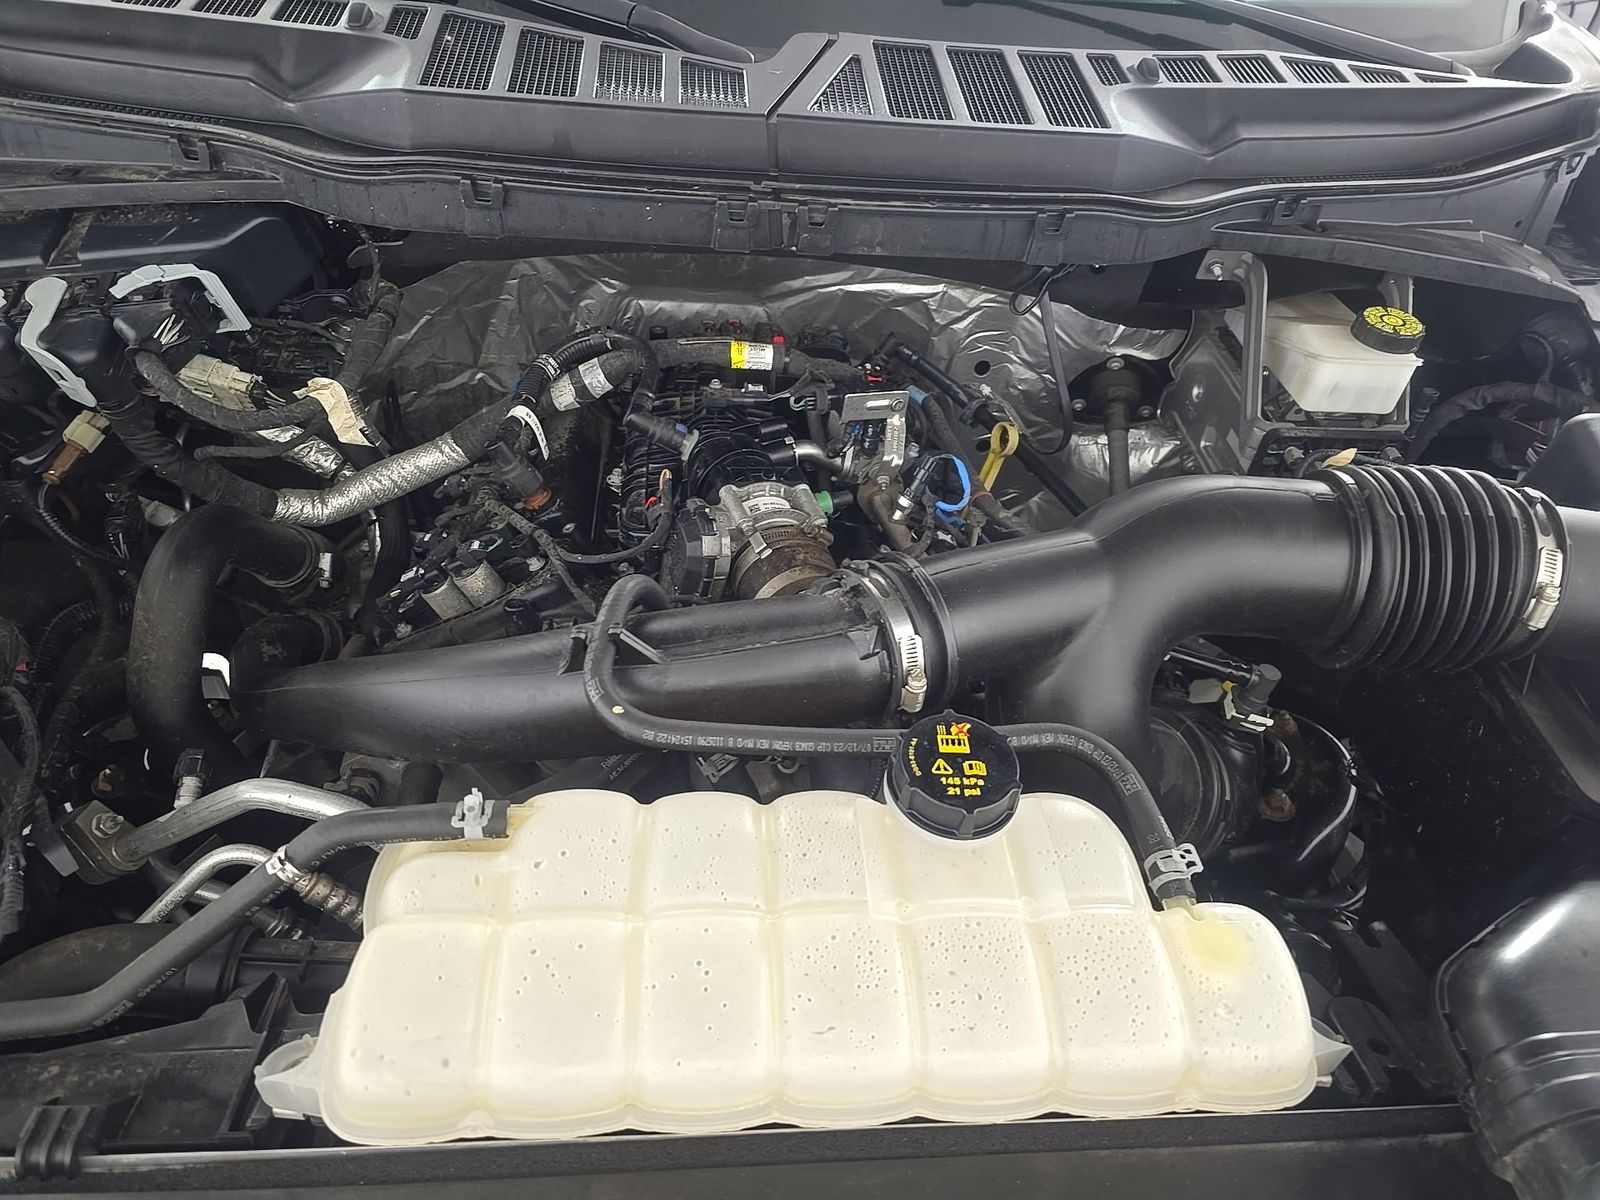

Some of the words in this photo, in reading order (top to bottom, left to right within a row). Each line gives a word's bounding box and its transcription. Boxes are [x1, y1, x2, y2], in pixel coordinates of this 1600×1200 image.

[641, 729, 655, 740] B2
[656, 733, 692, 746] 15:24:22
[833, 741, 872, 752] 07/12/23
[940, 776, 961, 786] 145
[962, 777, 985, 786] kPa
[947, 787, 961, 796] 21
[963, 788, 982, 798] psi
